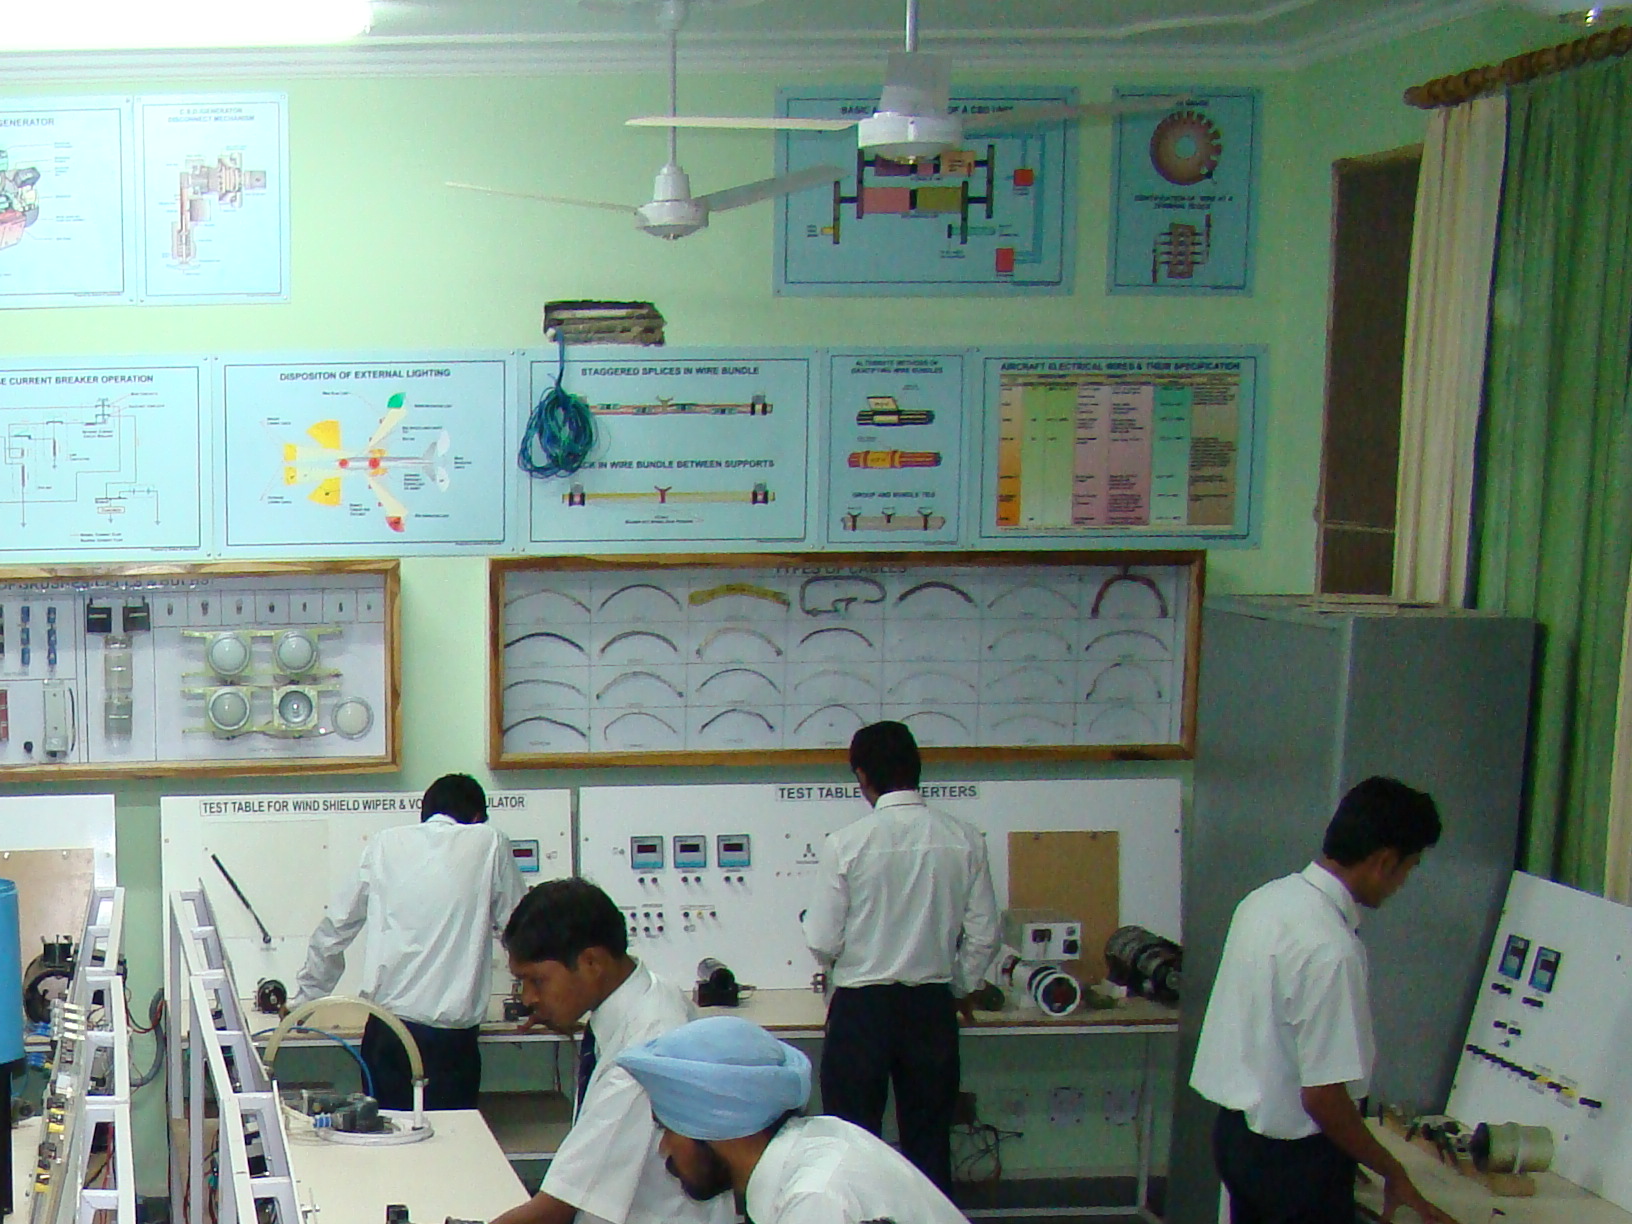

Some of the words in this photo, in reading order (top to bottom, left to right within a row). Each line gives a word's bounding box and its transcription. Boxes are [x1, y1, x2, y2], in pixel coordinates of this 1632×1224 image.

[581, 367, 640, 376] STAGGERED
[642, 367, 681, 376] SPLICES
[683, 367, 693, 375] IN
[695, 366, 719, 375] WIRE
[721, 366, 760, 375] BUNDLE
[1000, 362, 1046, 371] AIRCRAFT
[9, 376, 52, 386] CURRENT
[55, 375, 99, 385] BREAKER
[101, 374, 154, 384] OPERATION
[280, 371, 337, 381] DISPOSITON
[339, 371, 352, 380] OF
[354, 370, 404, 379] EXTERNAL
[406, 368, 451, 378] LIGHTING
[597, 460, 607, 469] IN
[610, 460, 633, 469] WIRE
[636, 460, 674, 469] BUNDLE
[676, 460, 722, 469] BETWEEN
[724, 459, 775, 468] SUPPORTS
[779, 787, 814, 799] TEST
[819, 787, 861, 799] TABLE
[202, 800, 230, 814] TEST
[232, 800, 265, 813] TABLE
[267, 800, 289, 813] FOR
[292, 800, 320, 812] WIND
[322, 799, 361, 812] SHIELD
[362, 798, 397, 811] WIPER
[399, 798, 407, 810] &
